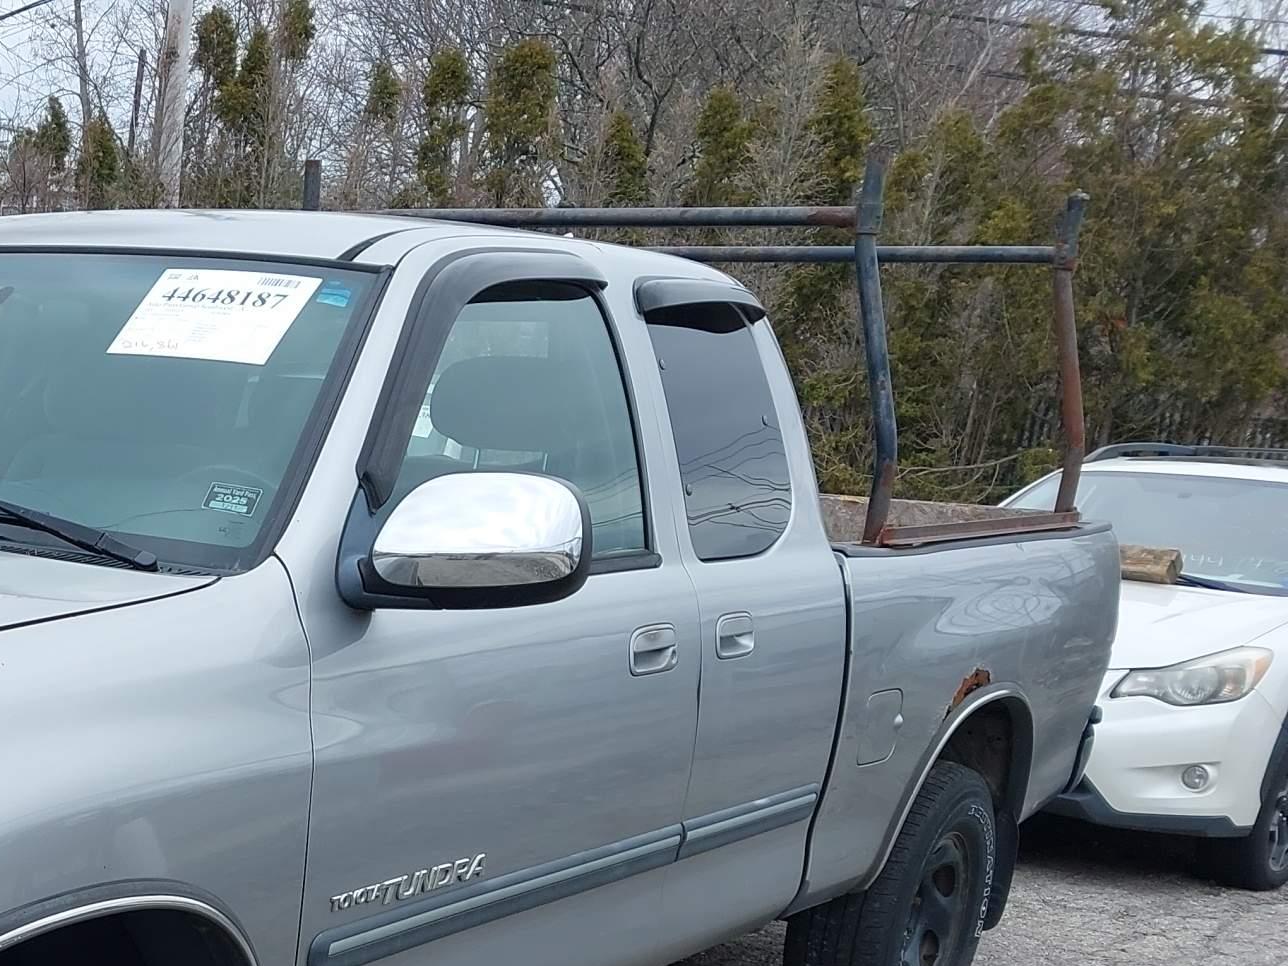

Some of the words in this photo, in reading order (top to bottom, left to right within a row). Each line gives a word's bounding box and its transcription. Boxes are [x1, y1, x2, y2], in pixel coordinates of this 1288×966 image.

[162, 287, 289, 309] 44648187
[215, 493, 248, 505] 2025
[381, 852, 487, 905] TUNDRA
